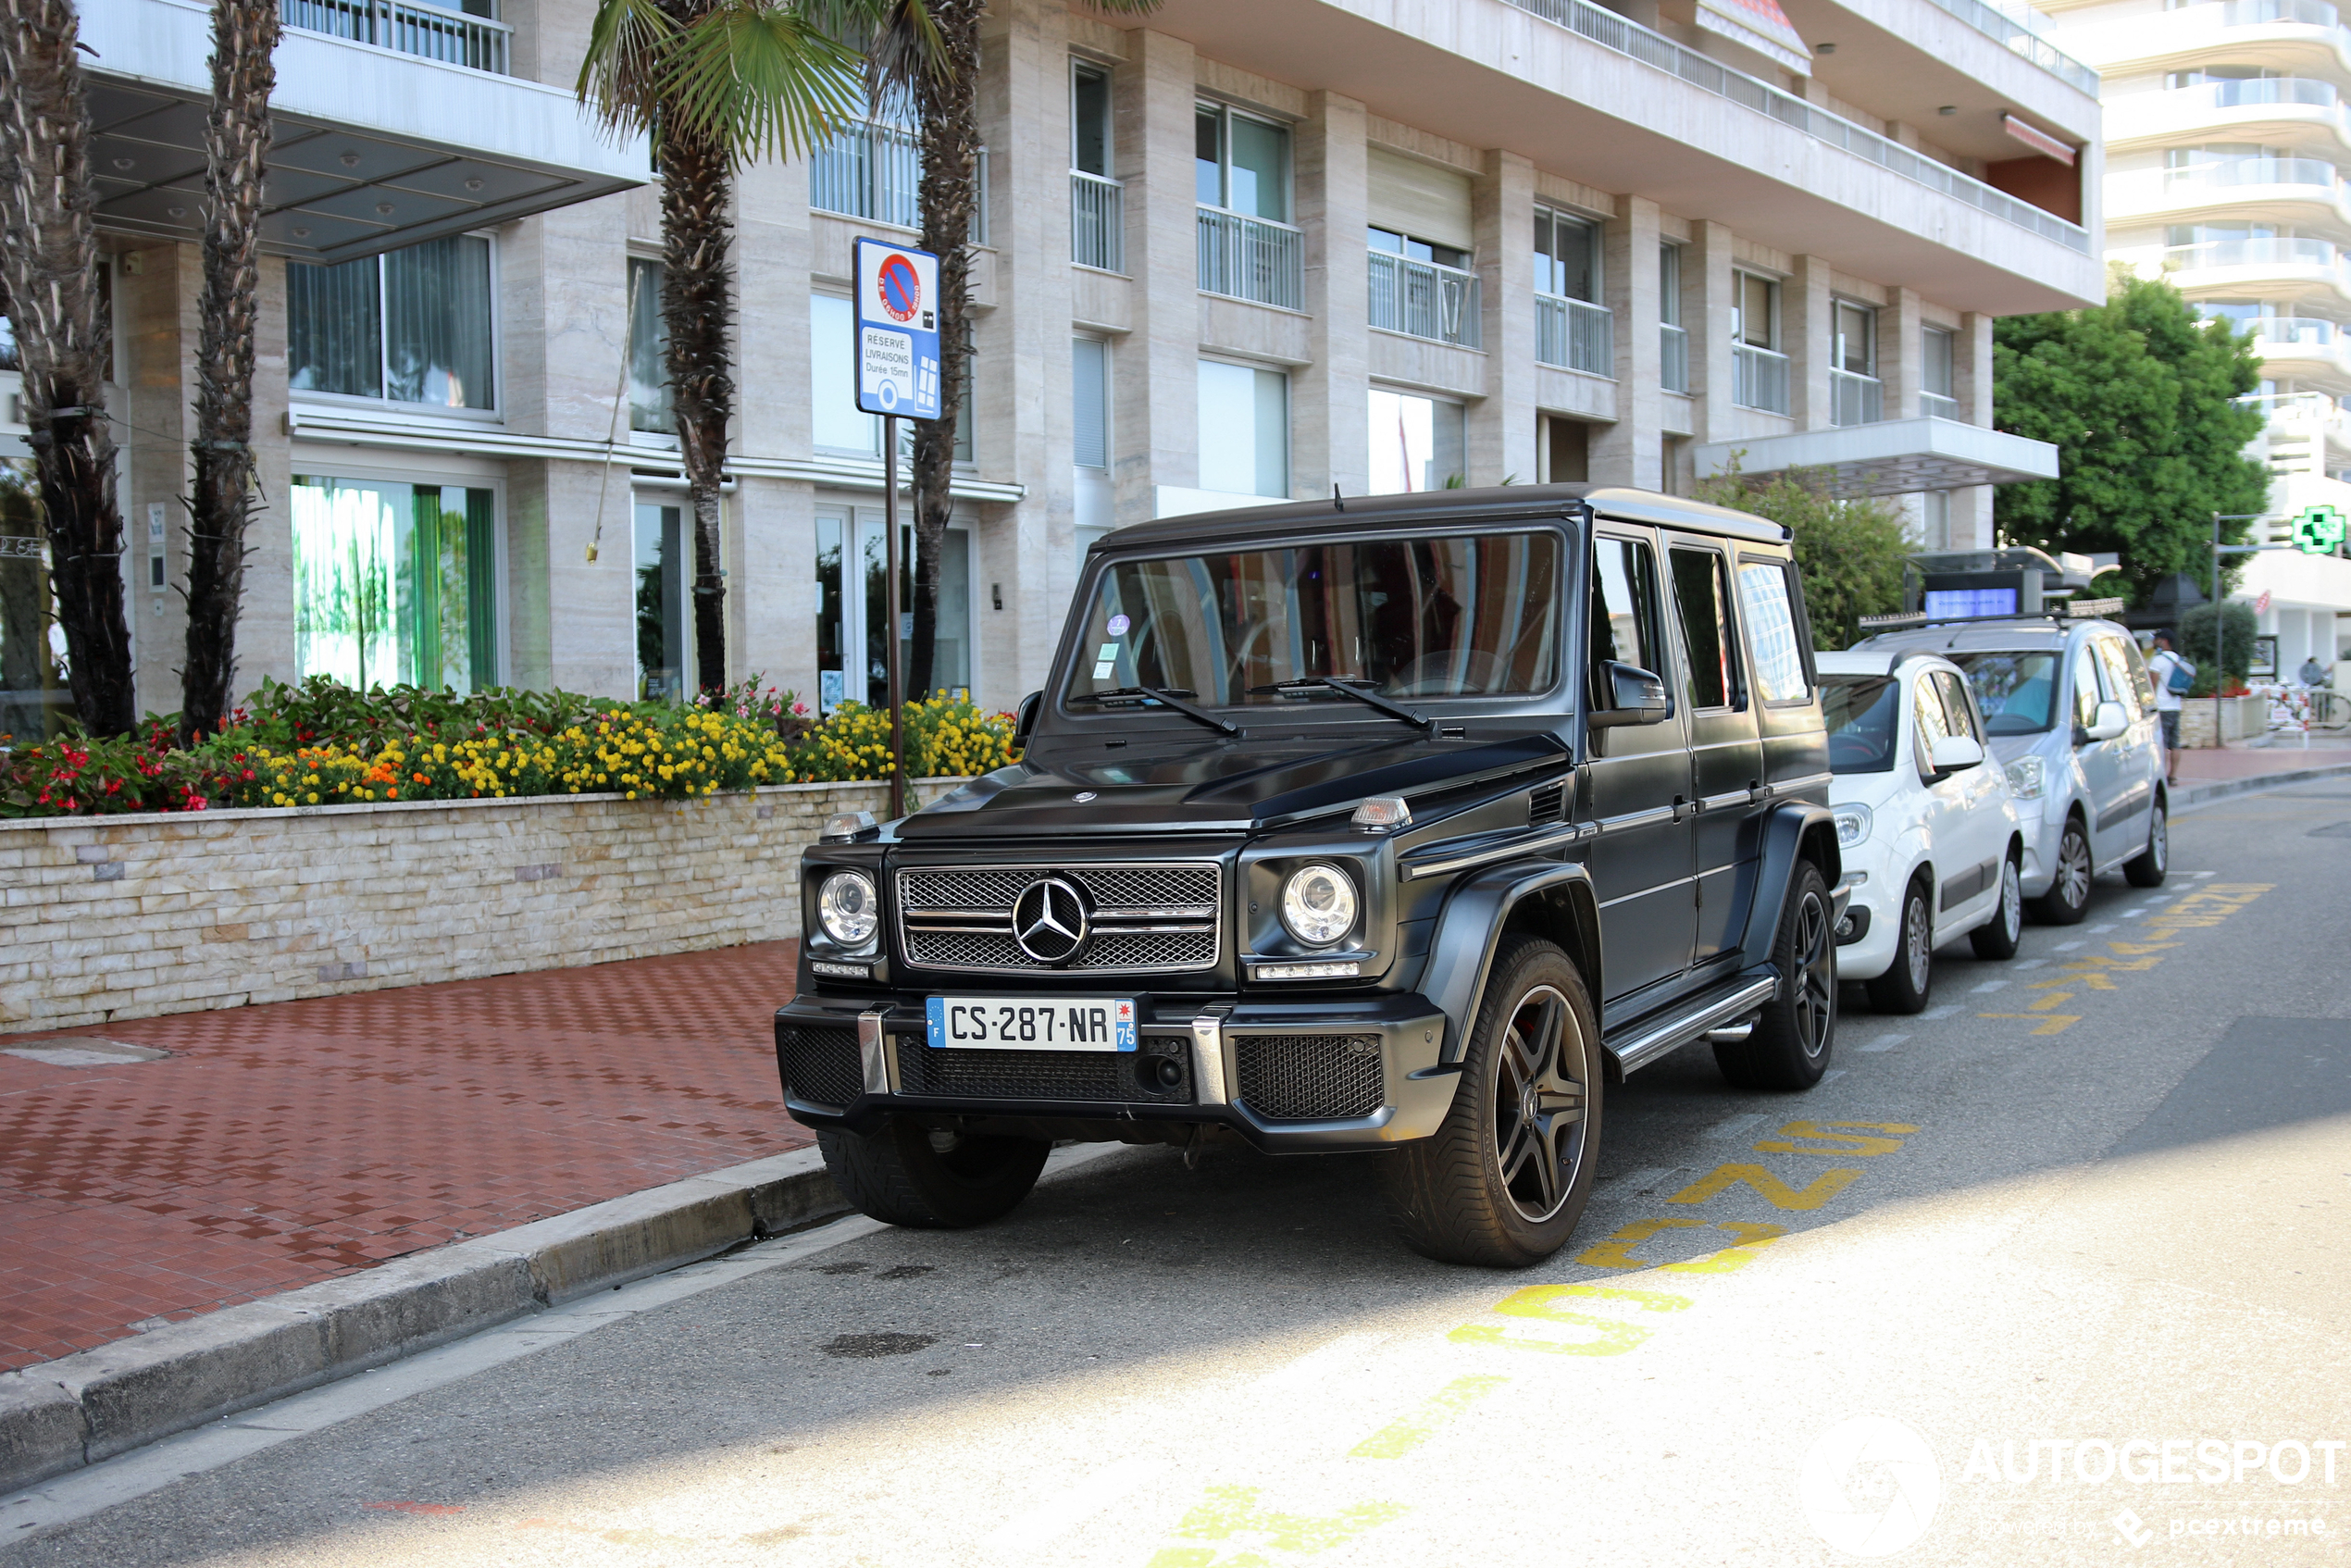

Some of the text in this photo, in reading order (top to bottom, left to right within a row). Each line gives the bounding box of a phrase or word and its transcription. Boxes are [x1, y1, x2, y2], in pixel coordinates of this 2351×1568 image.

[878, 277, 885, 292] DE
[866, 333, 905, 350] RÉSERVÉ
[865, 348, 909, 365] LIVRAISONS
[866, 362, 909, 378] Durée 15mn
[951, 1005, 1108, 1042] CS-287-NR
[933, 1027, 939, 1038] F
[1117, 1027, 1135, 1045] 75
[1485, 1121, 1500, 1198] YOKOHAMA
